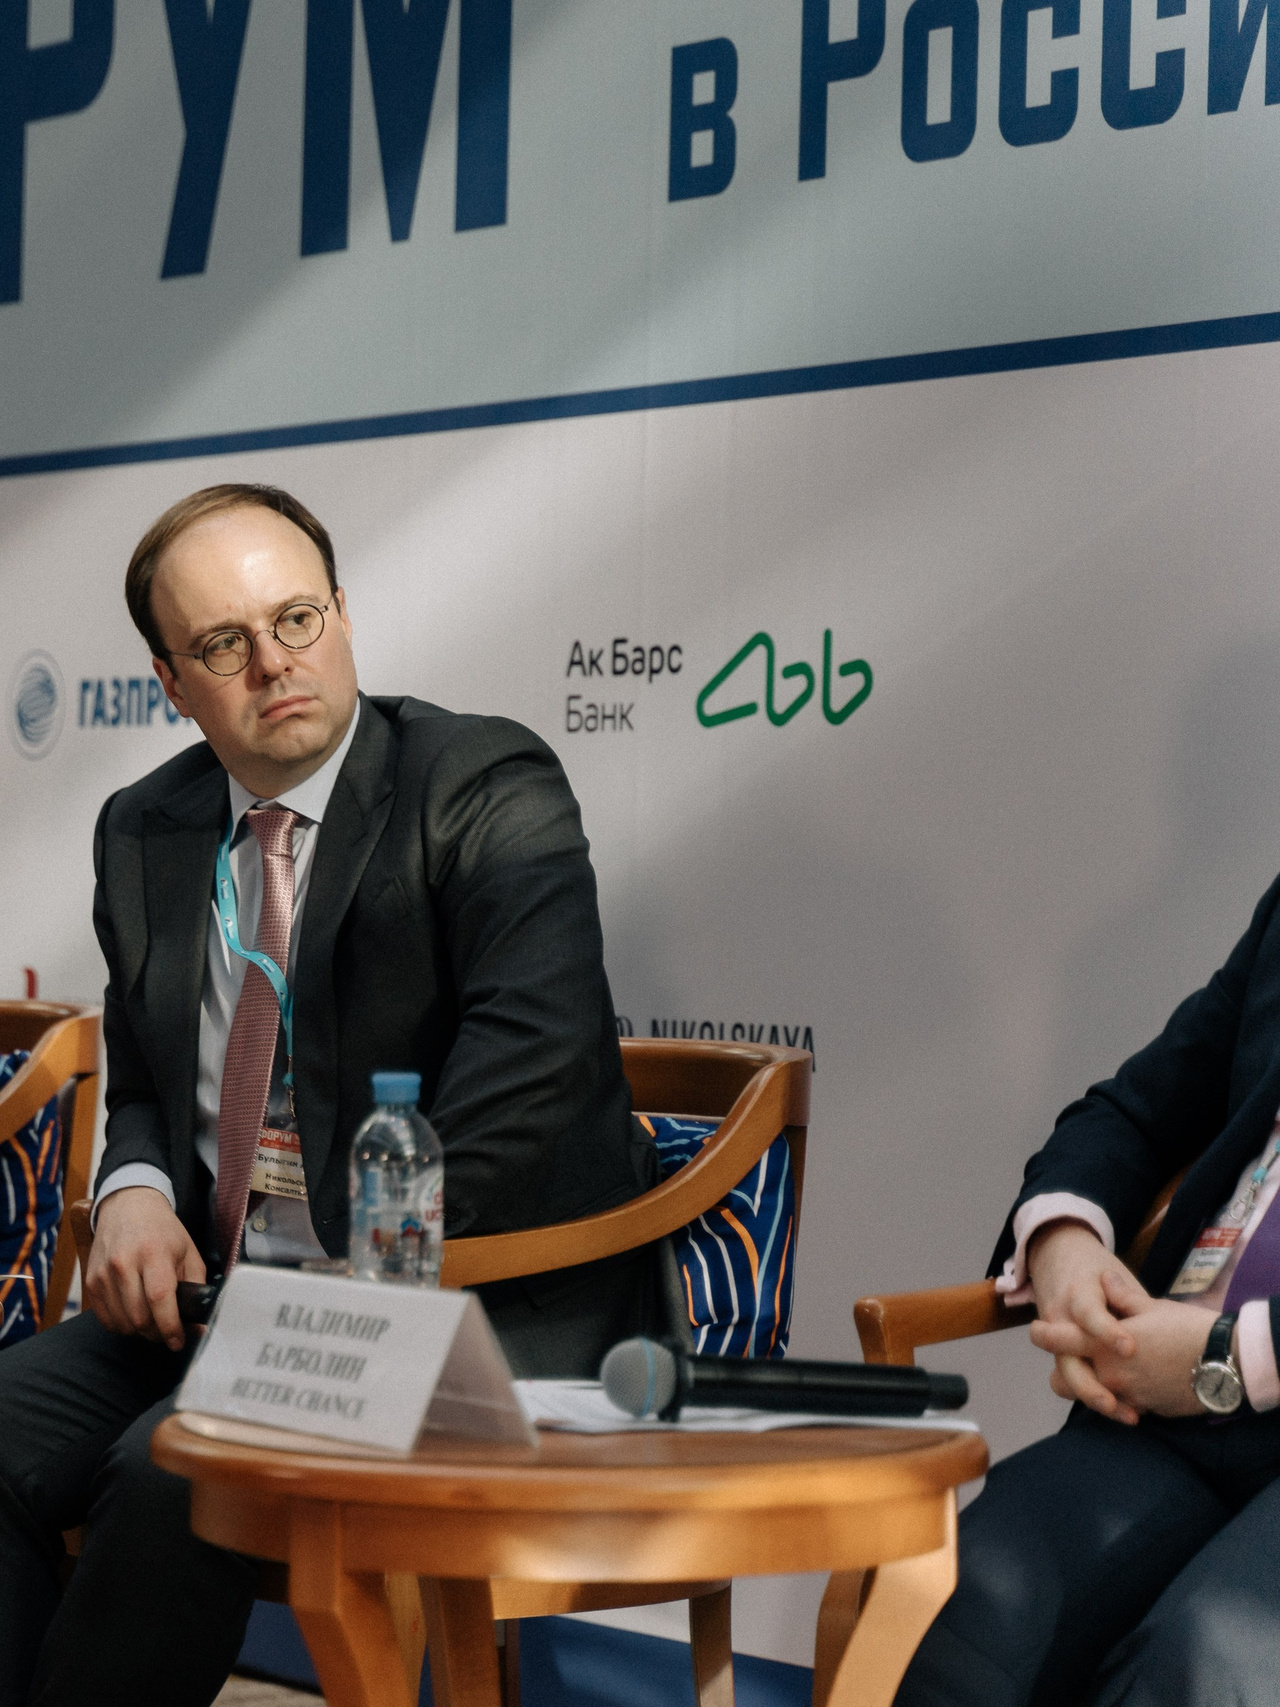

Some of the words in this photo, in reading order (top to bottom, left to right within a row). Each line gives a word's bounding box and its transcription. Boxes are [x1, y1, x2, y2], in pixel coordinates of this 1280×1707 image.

[567, 640, 604, 677] Ак
[611, 637, 683, 683] Барс
[78, 677, 194, 727] ГАЗПРО
[567, 695, 634, 732] Банк
[275, 1303, 391, 1342] ВЛАДИМИР
[255, 1342, 367, 1383] БАРБОЛИН
